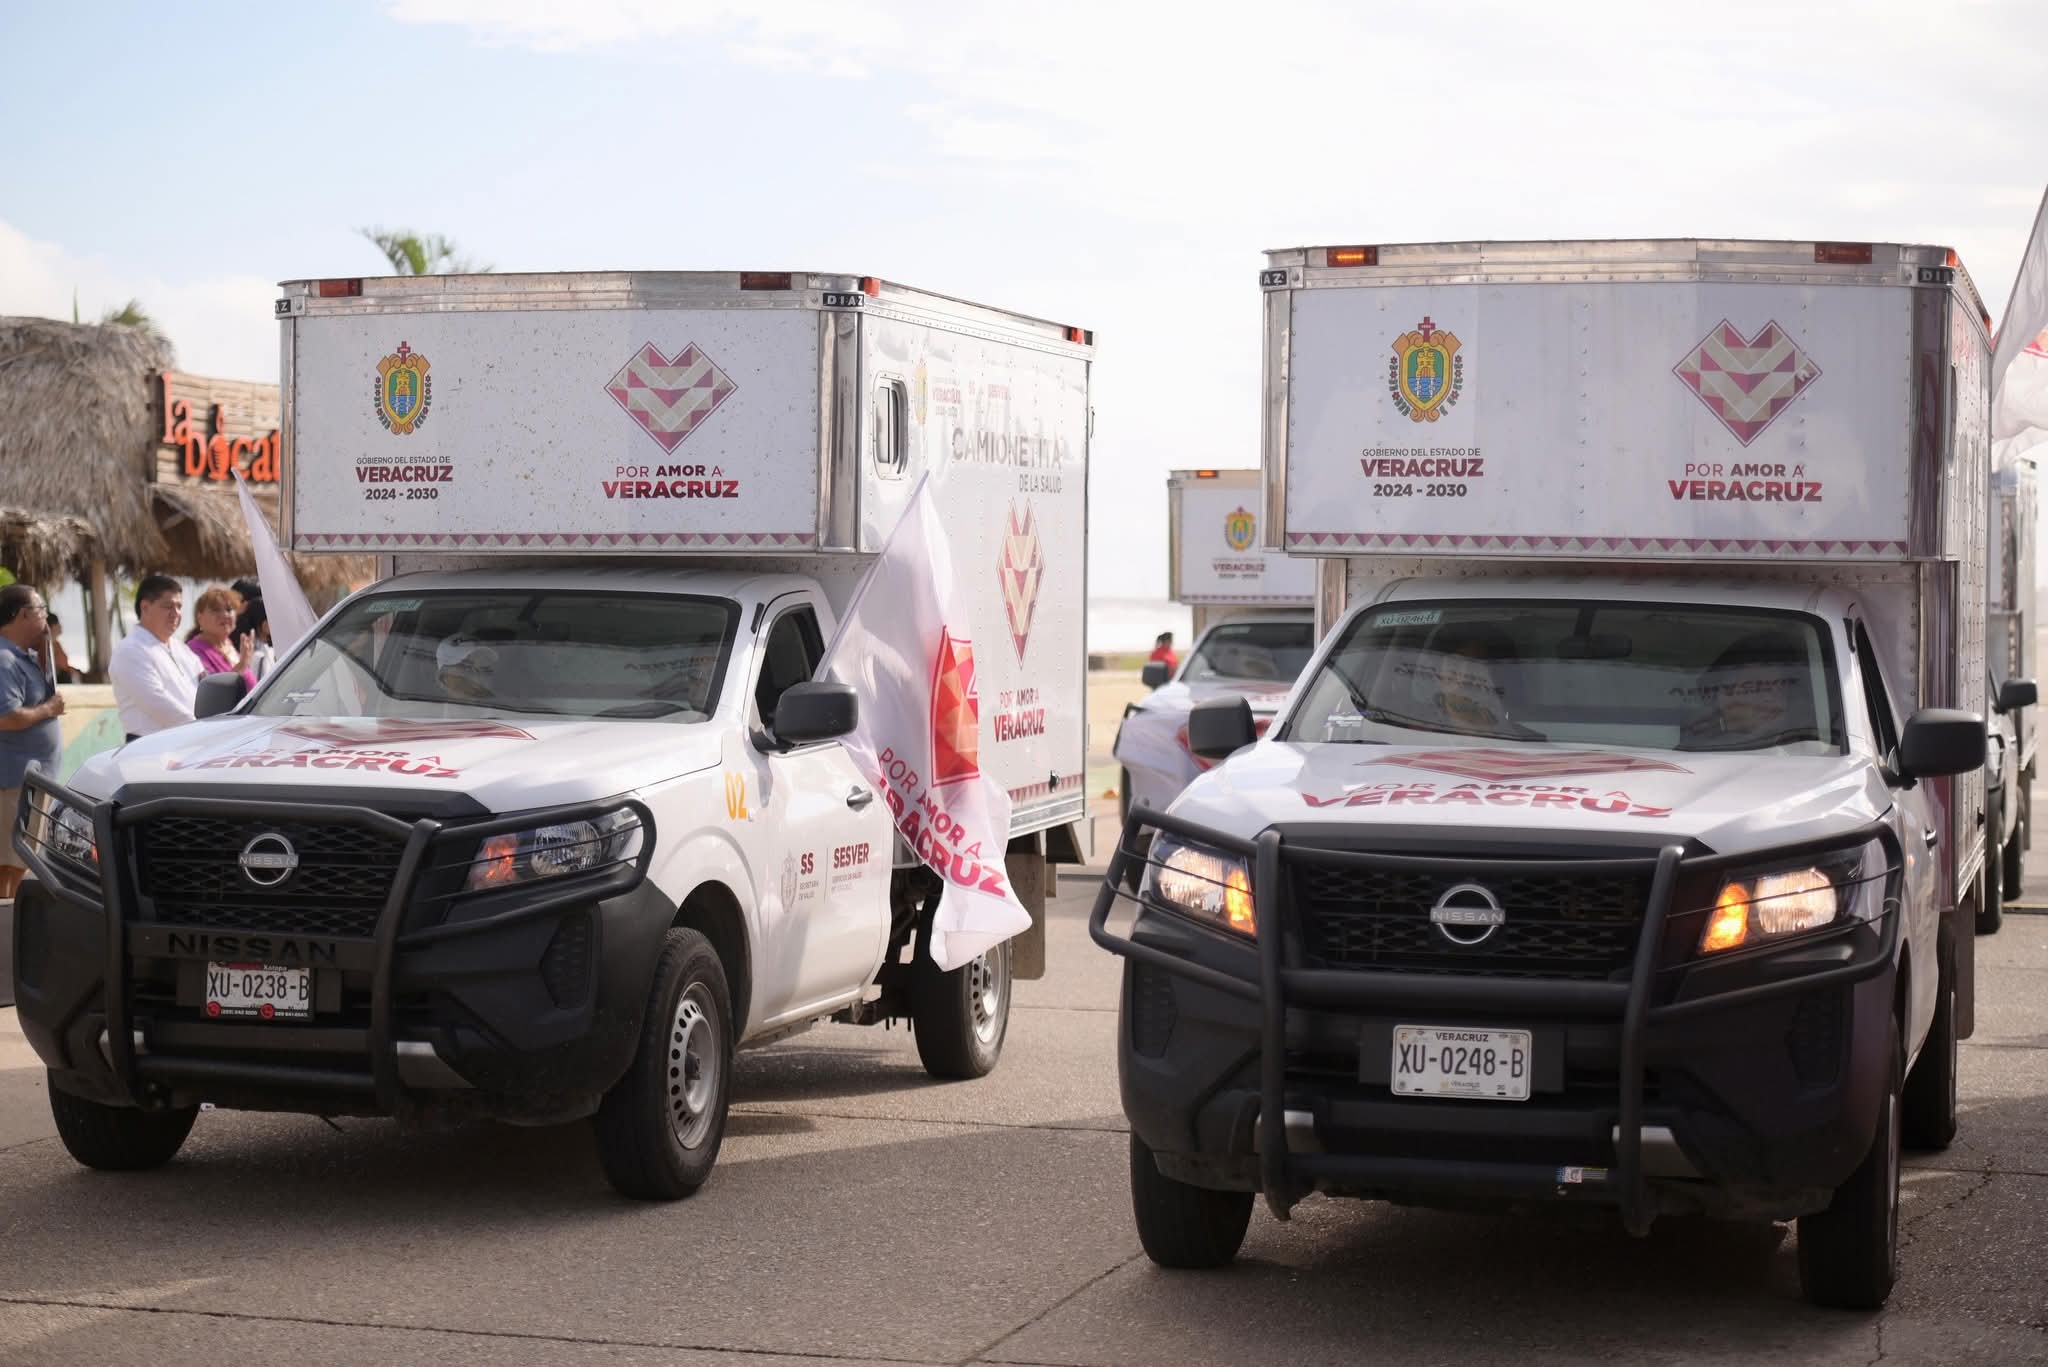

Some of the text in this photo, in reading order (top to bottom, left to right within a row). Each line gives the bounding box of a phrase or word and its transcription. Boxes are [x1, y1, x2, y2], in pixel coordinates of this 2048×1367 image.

[827, 295, 864, 306] DIAZ
[162, 371, 193, 445] la
[356, 457, 393, 465] GOBIERNO
[409, 456, 437, 464] ESTADO
[438, 456, 451, 464] DE
[1362, 447, 1481, 457] GOBIERNO DEL ESTADO DE
[355, 465, 453, 482] VERACRUZ
[616, 465, 722, 477] POR AMOR A
[1360, 458, 1484, 477] VERACRUZ
[1685, 464, 1804, 478] POR AMOR A
[601, 480, 739, 499] VERACRUZ
[1018, 473, 1029, 492] DE
[1030, 474, 1038, 492] LA
[1373, 484, 1413, 497] 2024
[1426, 484, 1468, 497] 2030
[1667, 480, 1823, 502] VERACRUZ
[365, 489, 396, 500] 2024
[406, 488, 439, 500] 2030
[1016, 688, 1034, 706] AMOR
[994, 708, 1044, 743] VERACRUZ
[294, 748, 411, 758] AMOR
[725, 772, 747, 820] 02
[1451, 783, 1589, 794] AMOR
[1604, 791, 1632, 802] A
[879, 747, 982, 860] POR AMOR A
[1301, 790, 1673, 818] VERACRUZ
[239, 854, 298, 866] NISSAN
[800, 852, 814, 875] SS
[833, 842, 870, 868] SESVER
[1432, 910, 1504, 922] NISSAN
[168, 932, 338, 963] NISSAN
[208, 972, 310, 1001] XU-0238-B
[1435, 1031, 1489, 1042] VERACRUZ
[1399, 1043, 1524, 1078] XU-0248-B
